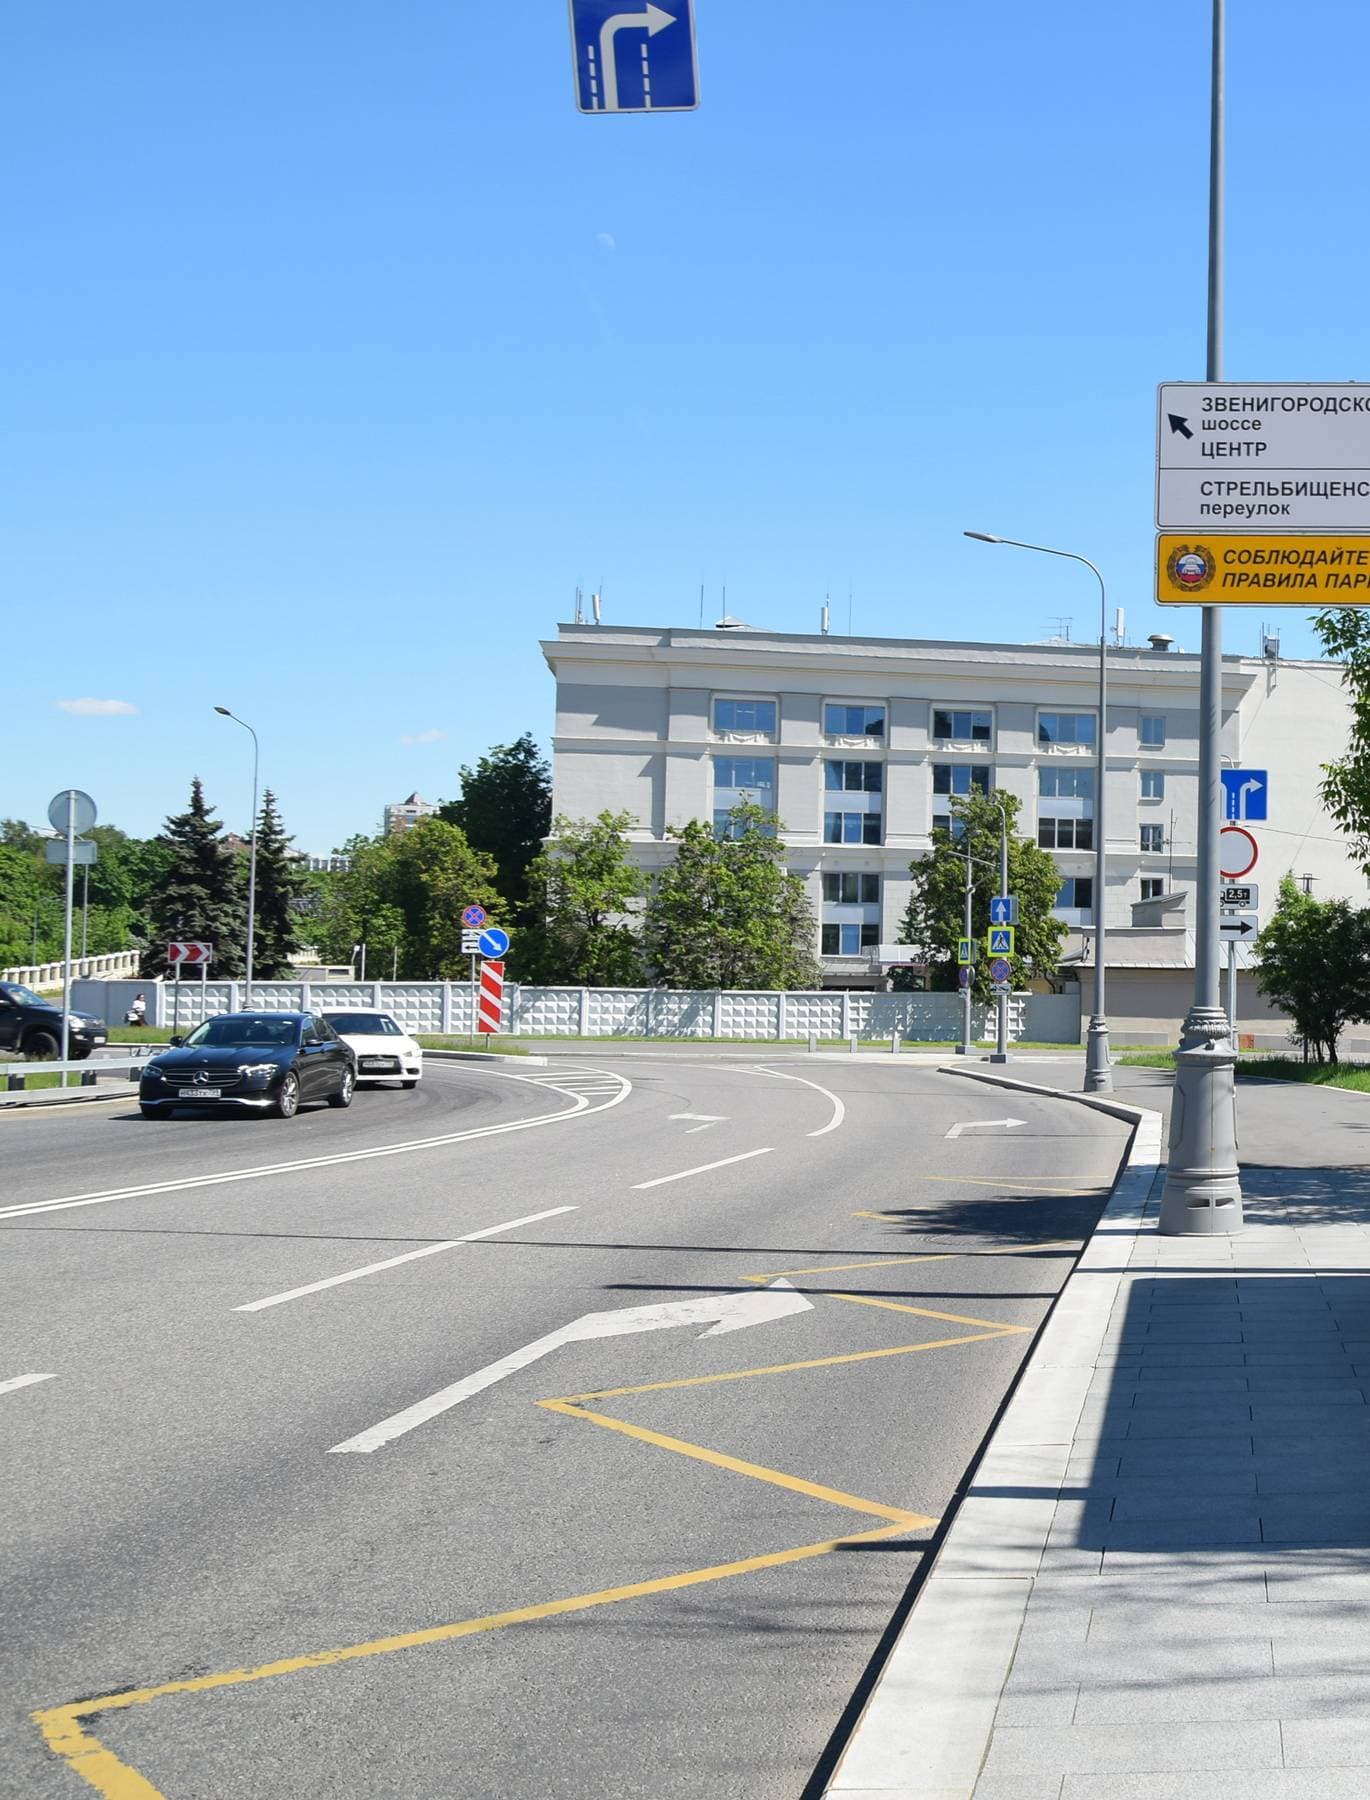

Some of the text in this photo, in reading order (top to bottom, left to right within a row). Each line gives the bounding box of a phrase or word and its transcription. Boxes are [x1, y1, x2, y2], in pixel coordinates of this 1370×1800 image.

[1202, 418, 1262, 431] шоссе
[1201, 441, 1267, 460] ЦЕНТР
[1200, 501, 1290, 519] переулок
[1222, 547, 1370, 566] СОБЛЮДАЙТЕ
[1221, 572, 1318, 588] ПРАВИЛА
